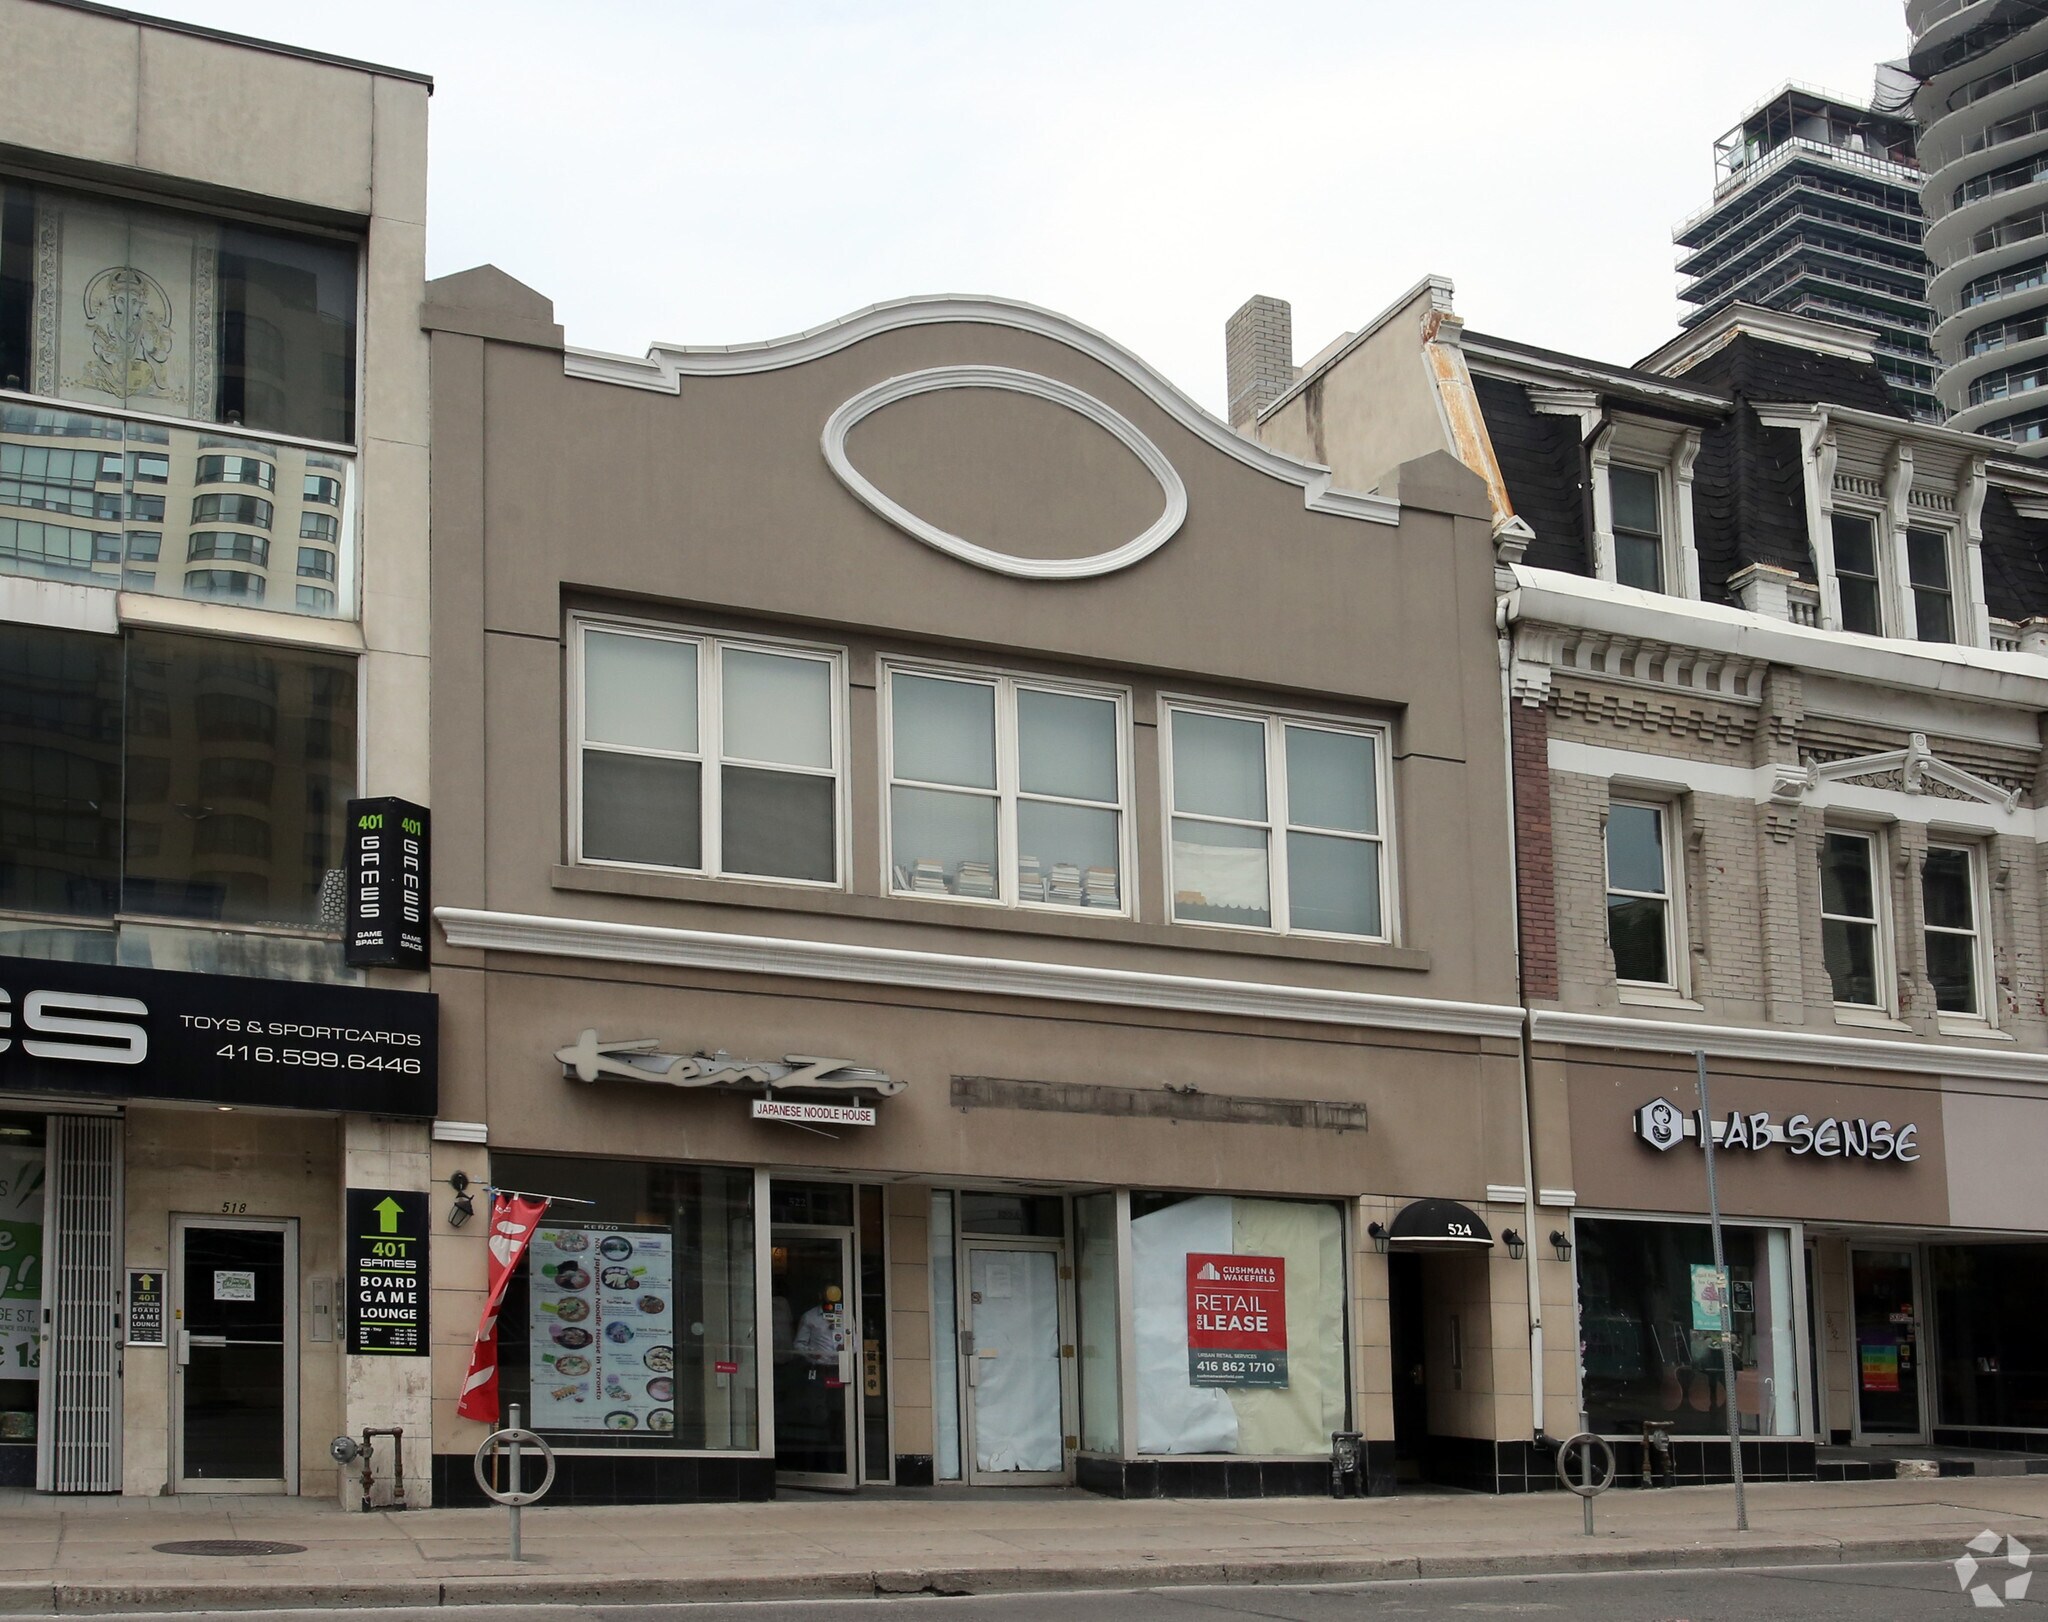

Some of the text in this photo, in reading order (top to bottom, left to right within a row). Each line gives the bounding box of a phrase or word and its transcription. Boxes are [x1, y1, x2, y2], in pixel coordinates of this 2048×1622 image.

[358, 814, 383, 830] 401
[401, 817, 421, 836] 401
[360, 835, 380, 918] GAMES
[403, 838, 419, 923] GAMES
[357, 930, 383, 939] GAME
[401, 932, 422, 944] GAME
[355, 938, 384, 946] SPACE
[400, 940, 423, 951] SPACE
[0, 987, 149, 1065] S
[180, 1014, 421, 1046] TOYS & SPORTCARDS
[216, 1044, 421, 1074] 416.599.6446
[757, 1103, 871, 1122] JAPANESE NOODLE HOUSE
[1695, 1109, 1920, 1163] LAB SENSE
[222, 1202, 247, 1213] 518
[1447, 1223, 1472, 1237] 524
[372, 1242, 406, 1257] 401
[360, 1258, 417, 1269] GAMES
[1222, 1266, 1267, 1275] CUSHMAN
[360, 1276, 417, 1288] BOARD
[1222, 1274, 1276, 1283] WAKEFIELD
[138, 1294, 155, 1302] 401
[360, 1290, 417, 1304] GAME
[1195, 1293, 1267, 1313] RETAIL
[16, 1309, 35, 1323] ST.
[360, 1307, 417, 1320] LOUNGE
[1203, 1314, 1269, 1332] LEASE
[595, 1356, 602, 1364] in
[1196, 1361, 1276, 1373] 416 862 1710
